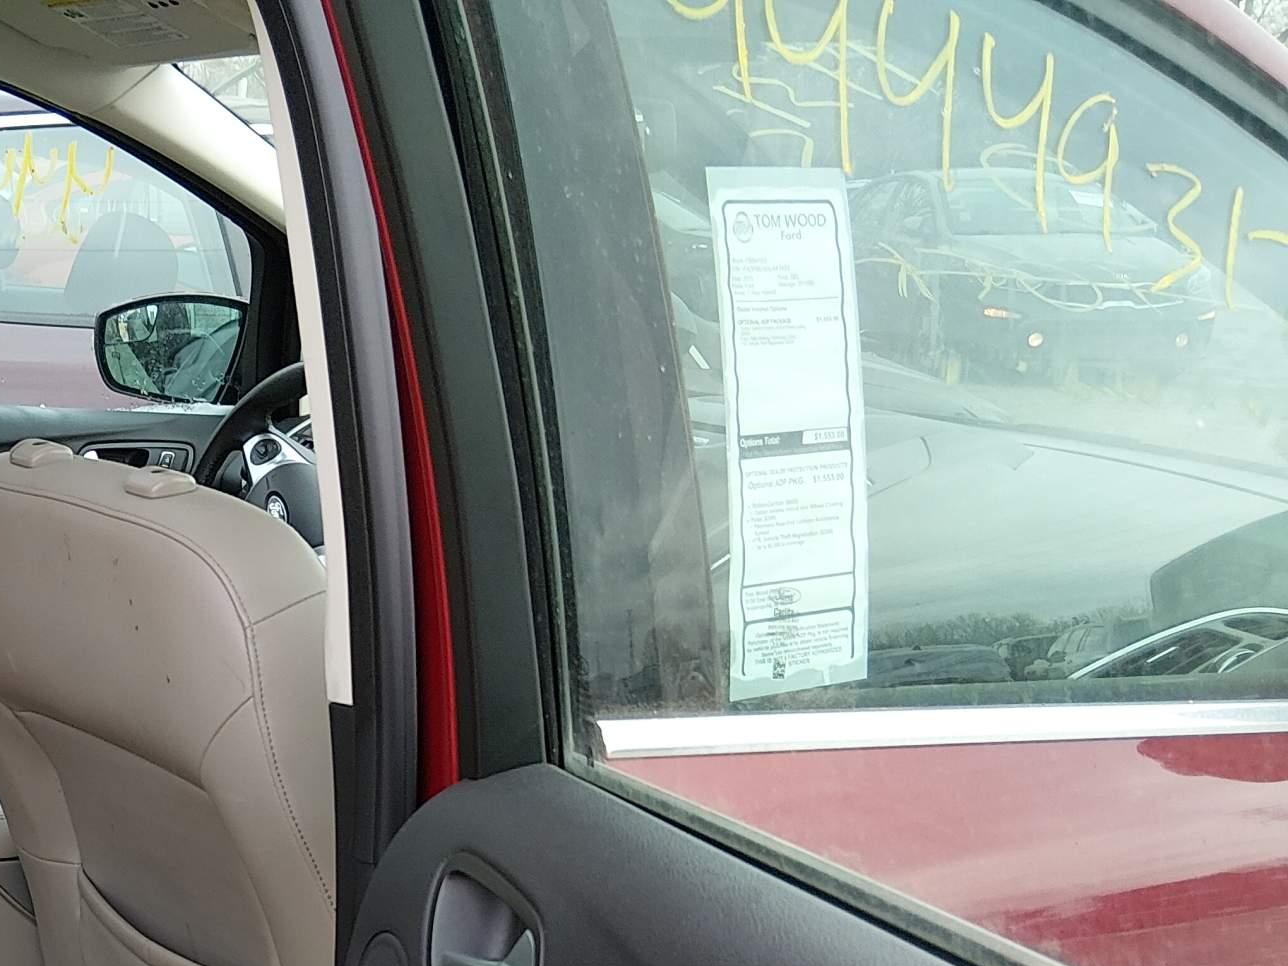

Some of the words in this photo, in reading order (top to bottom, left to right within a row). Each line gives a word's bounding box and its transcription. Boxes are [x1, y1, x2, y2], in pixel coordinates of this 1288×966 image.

[753, 214, 781, 229] TOM
[784, 213, 827, 228] WOOD
[780, 230, 802, 241] Ford
[740, 437, 763, 448] Options
